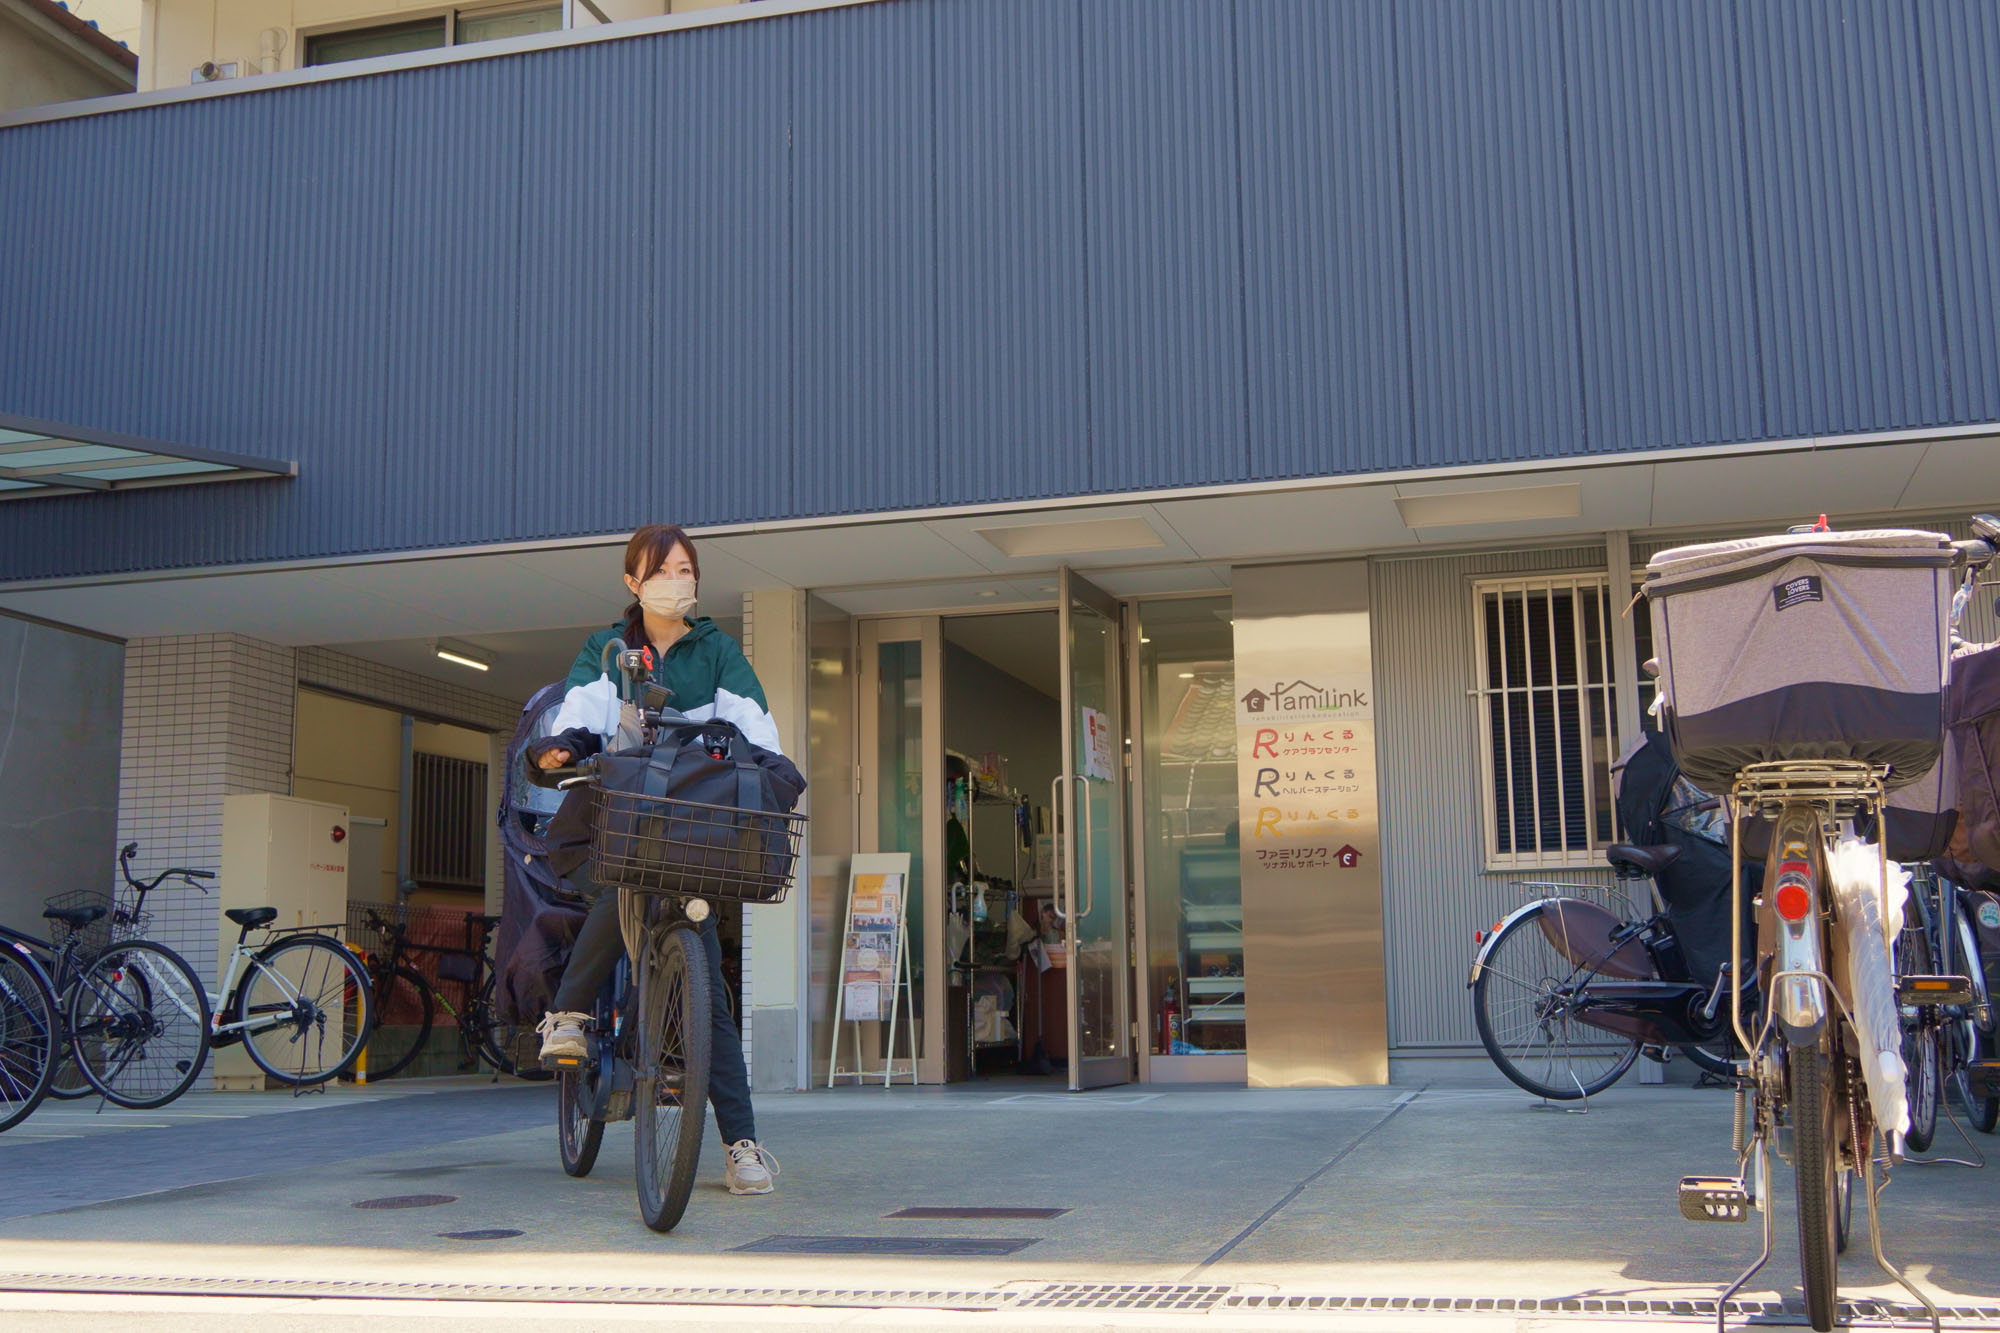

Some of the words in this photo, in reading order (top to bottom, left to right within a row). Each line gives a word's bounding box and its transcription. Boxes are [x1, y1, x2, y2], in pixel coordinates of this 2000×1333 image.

[1785, 578, 1809, 591] COVERS
[1787, 584, 1811, 596] LOVERS
[1270, 680, 1368, 711] familink
[1284, 729, 1354, 742] りんくる
[1282, 746, 1359, 756] ケアプランセンター
[1285, 769, 1355, 782] りんくる
[1282, 784, 1360, 795] ヘルパーステーション
[1287, 809, 1360, 821] りんくる
[1256, 848, 1327, 860] ファミリンク
[1263, 860, 1330, 869] ツナガルサポート
